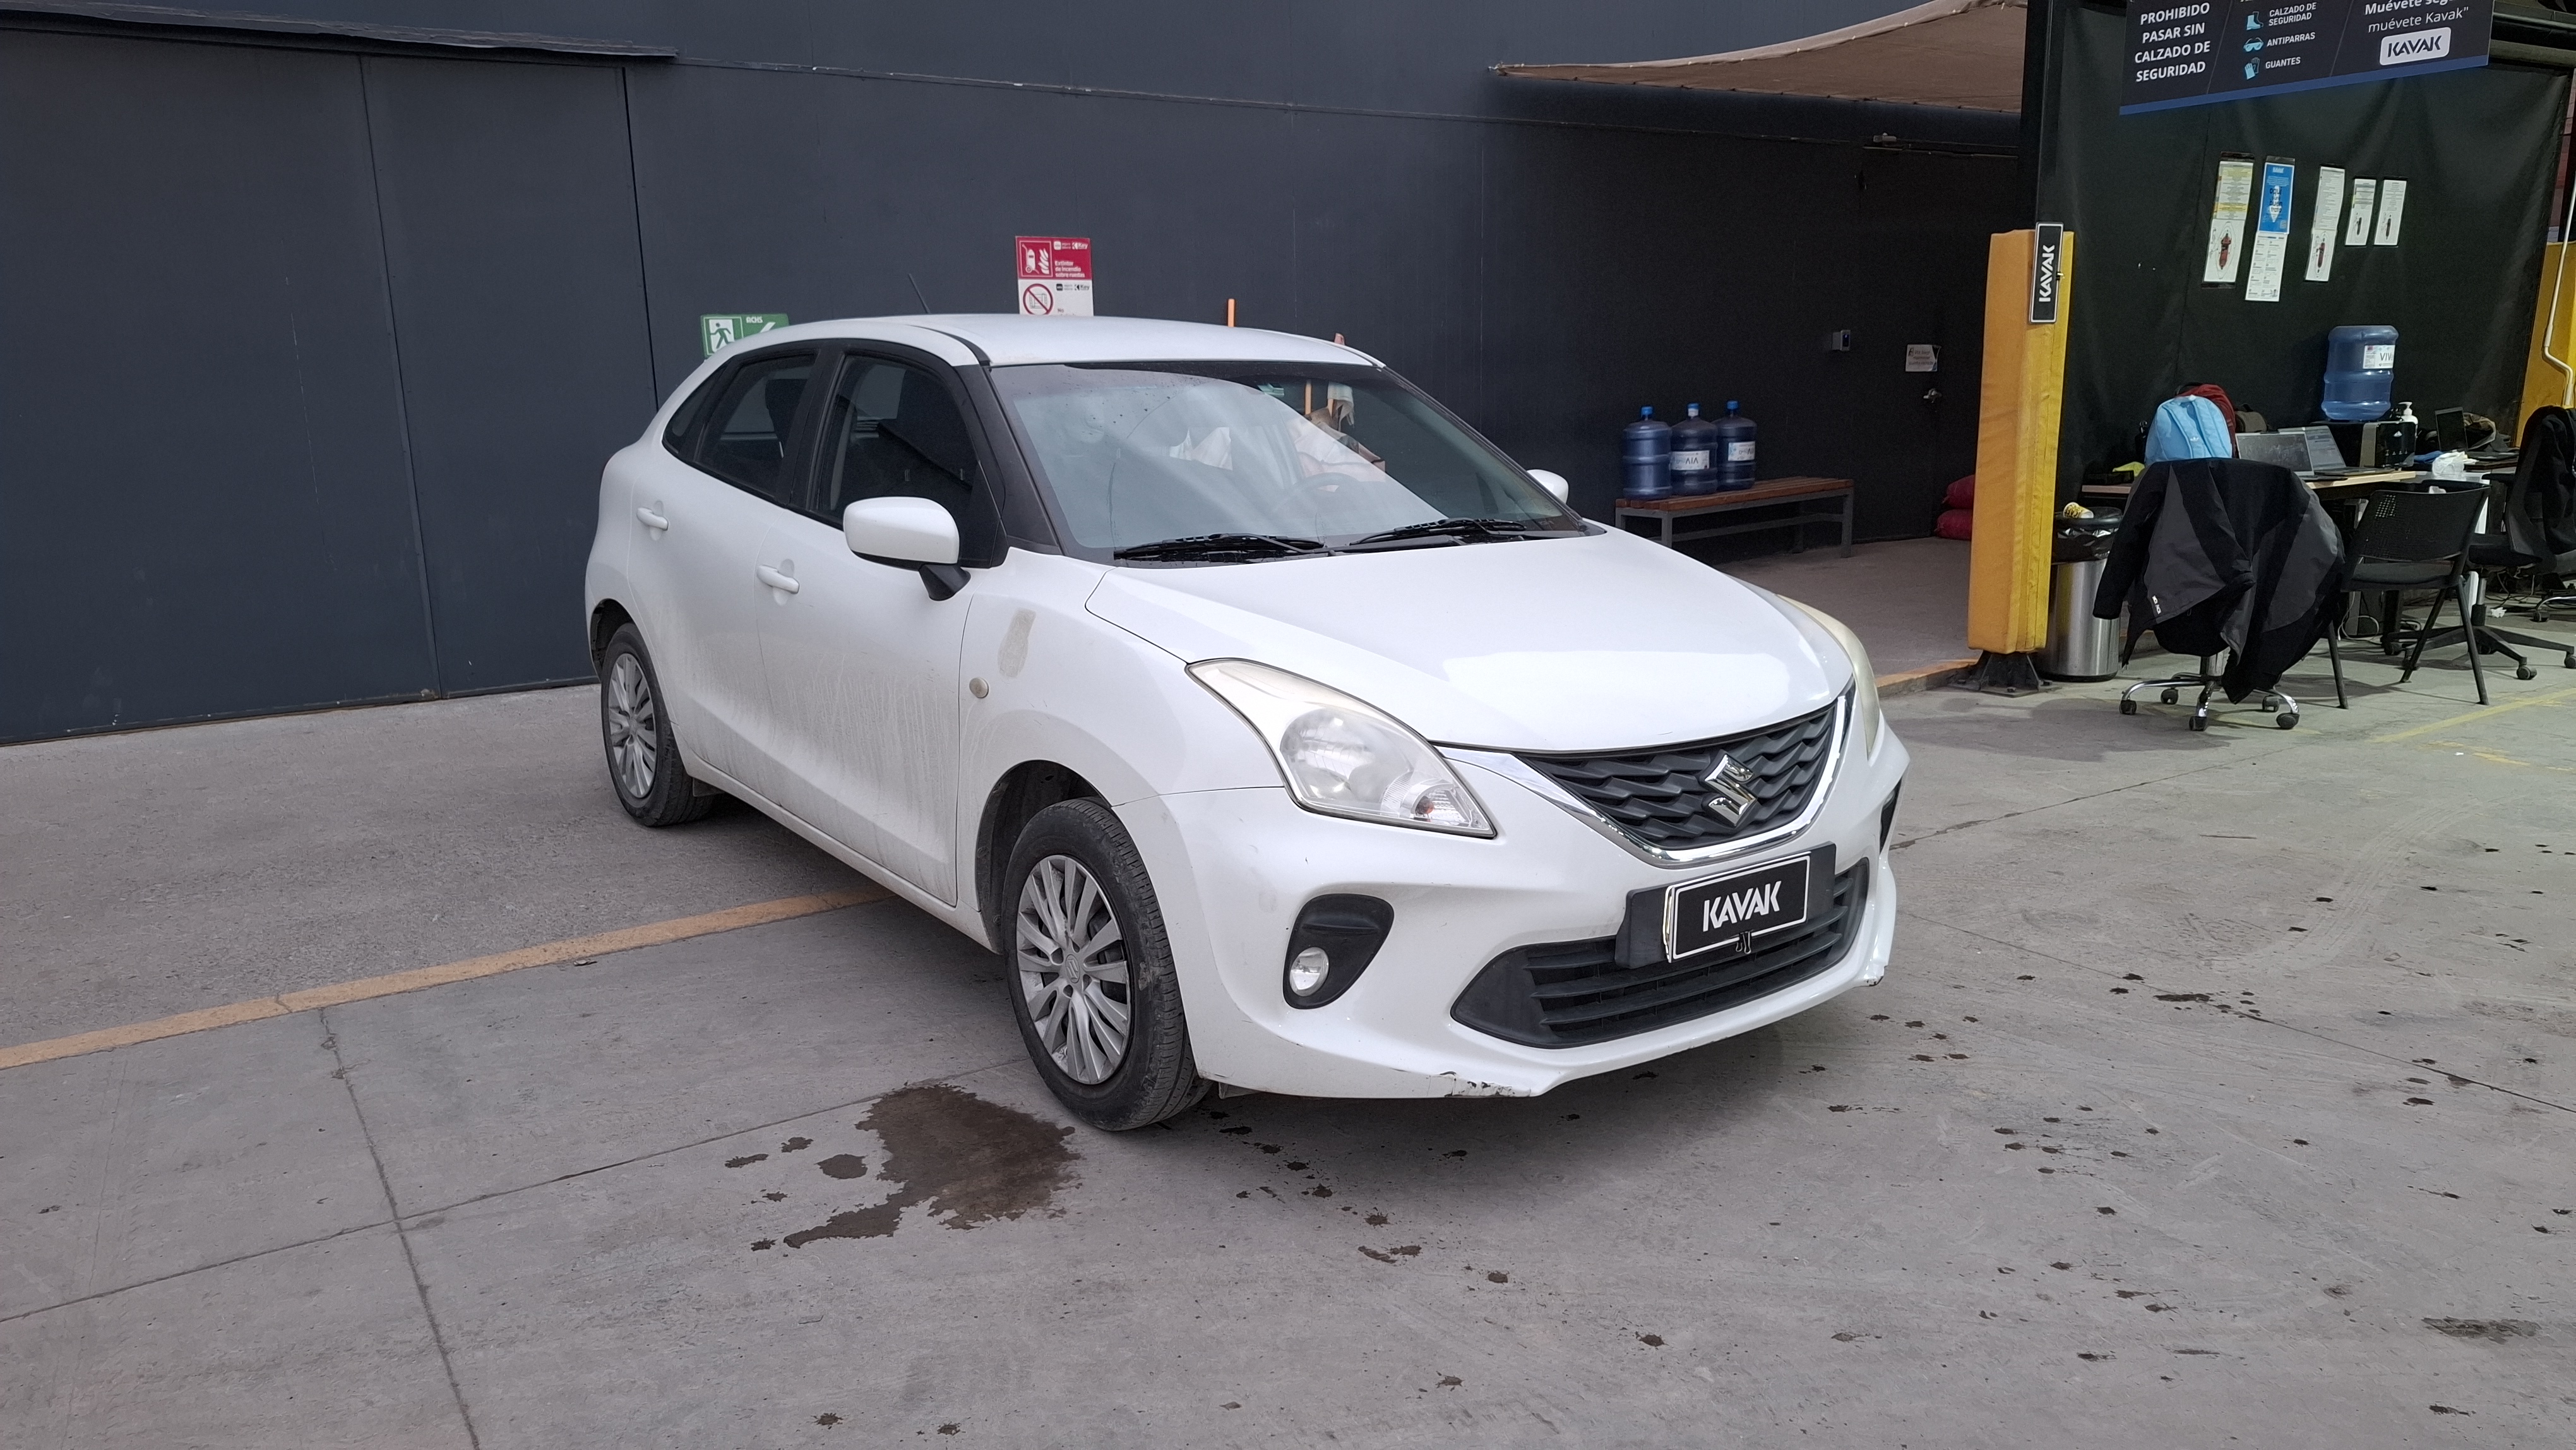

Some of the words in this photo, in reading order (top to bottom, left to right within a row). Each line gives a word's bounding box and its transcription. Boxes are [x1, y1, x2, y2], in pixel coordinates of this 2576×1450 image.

[2140, 3, 2210, 25] PROHIBIDO
[2269, 4, 2305, 17] CALZADO
[2306, 2, 2317, 11] DE
[2364, 0, 2423, 15] Muévete
[2269, 12, 2312, 27] SEGURIDAD
[2368, 16, 2422, 33] muévete
[2142, 27, 2181, 44] PASAR
[2183, 22, 2205, 37] SIN
[2267, 32, 2316, 47] ANTIPARRAS
[2135, 44, 2191, 63] CALZADO
[2194, 40, 2210, 54] DE
[2388, 35, 2442, 57] KAVAK
[2135, 61, 2206, 82] SEGURIDAD
[2265, 56, 2301, 69] GUANTES
[2039, 244, 2055, 302] KAVAK
[1703, 881, 1782, 932] KAVAK
